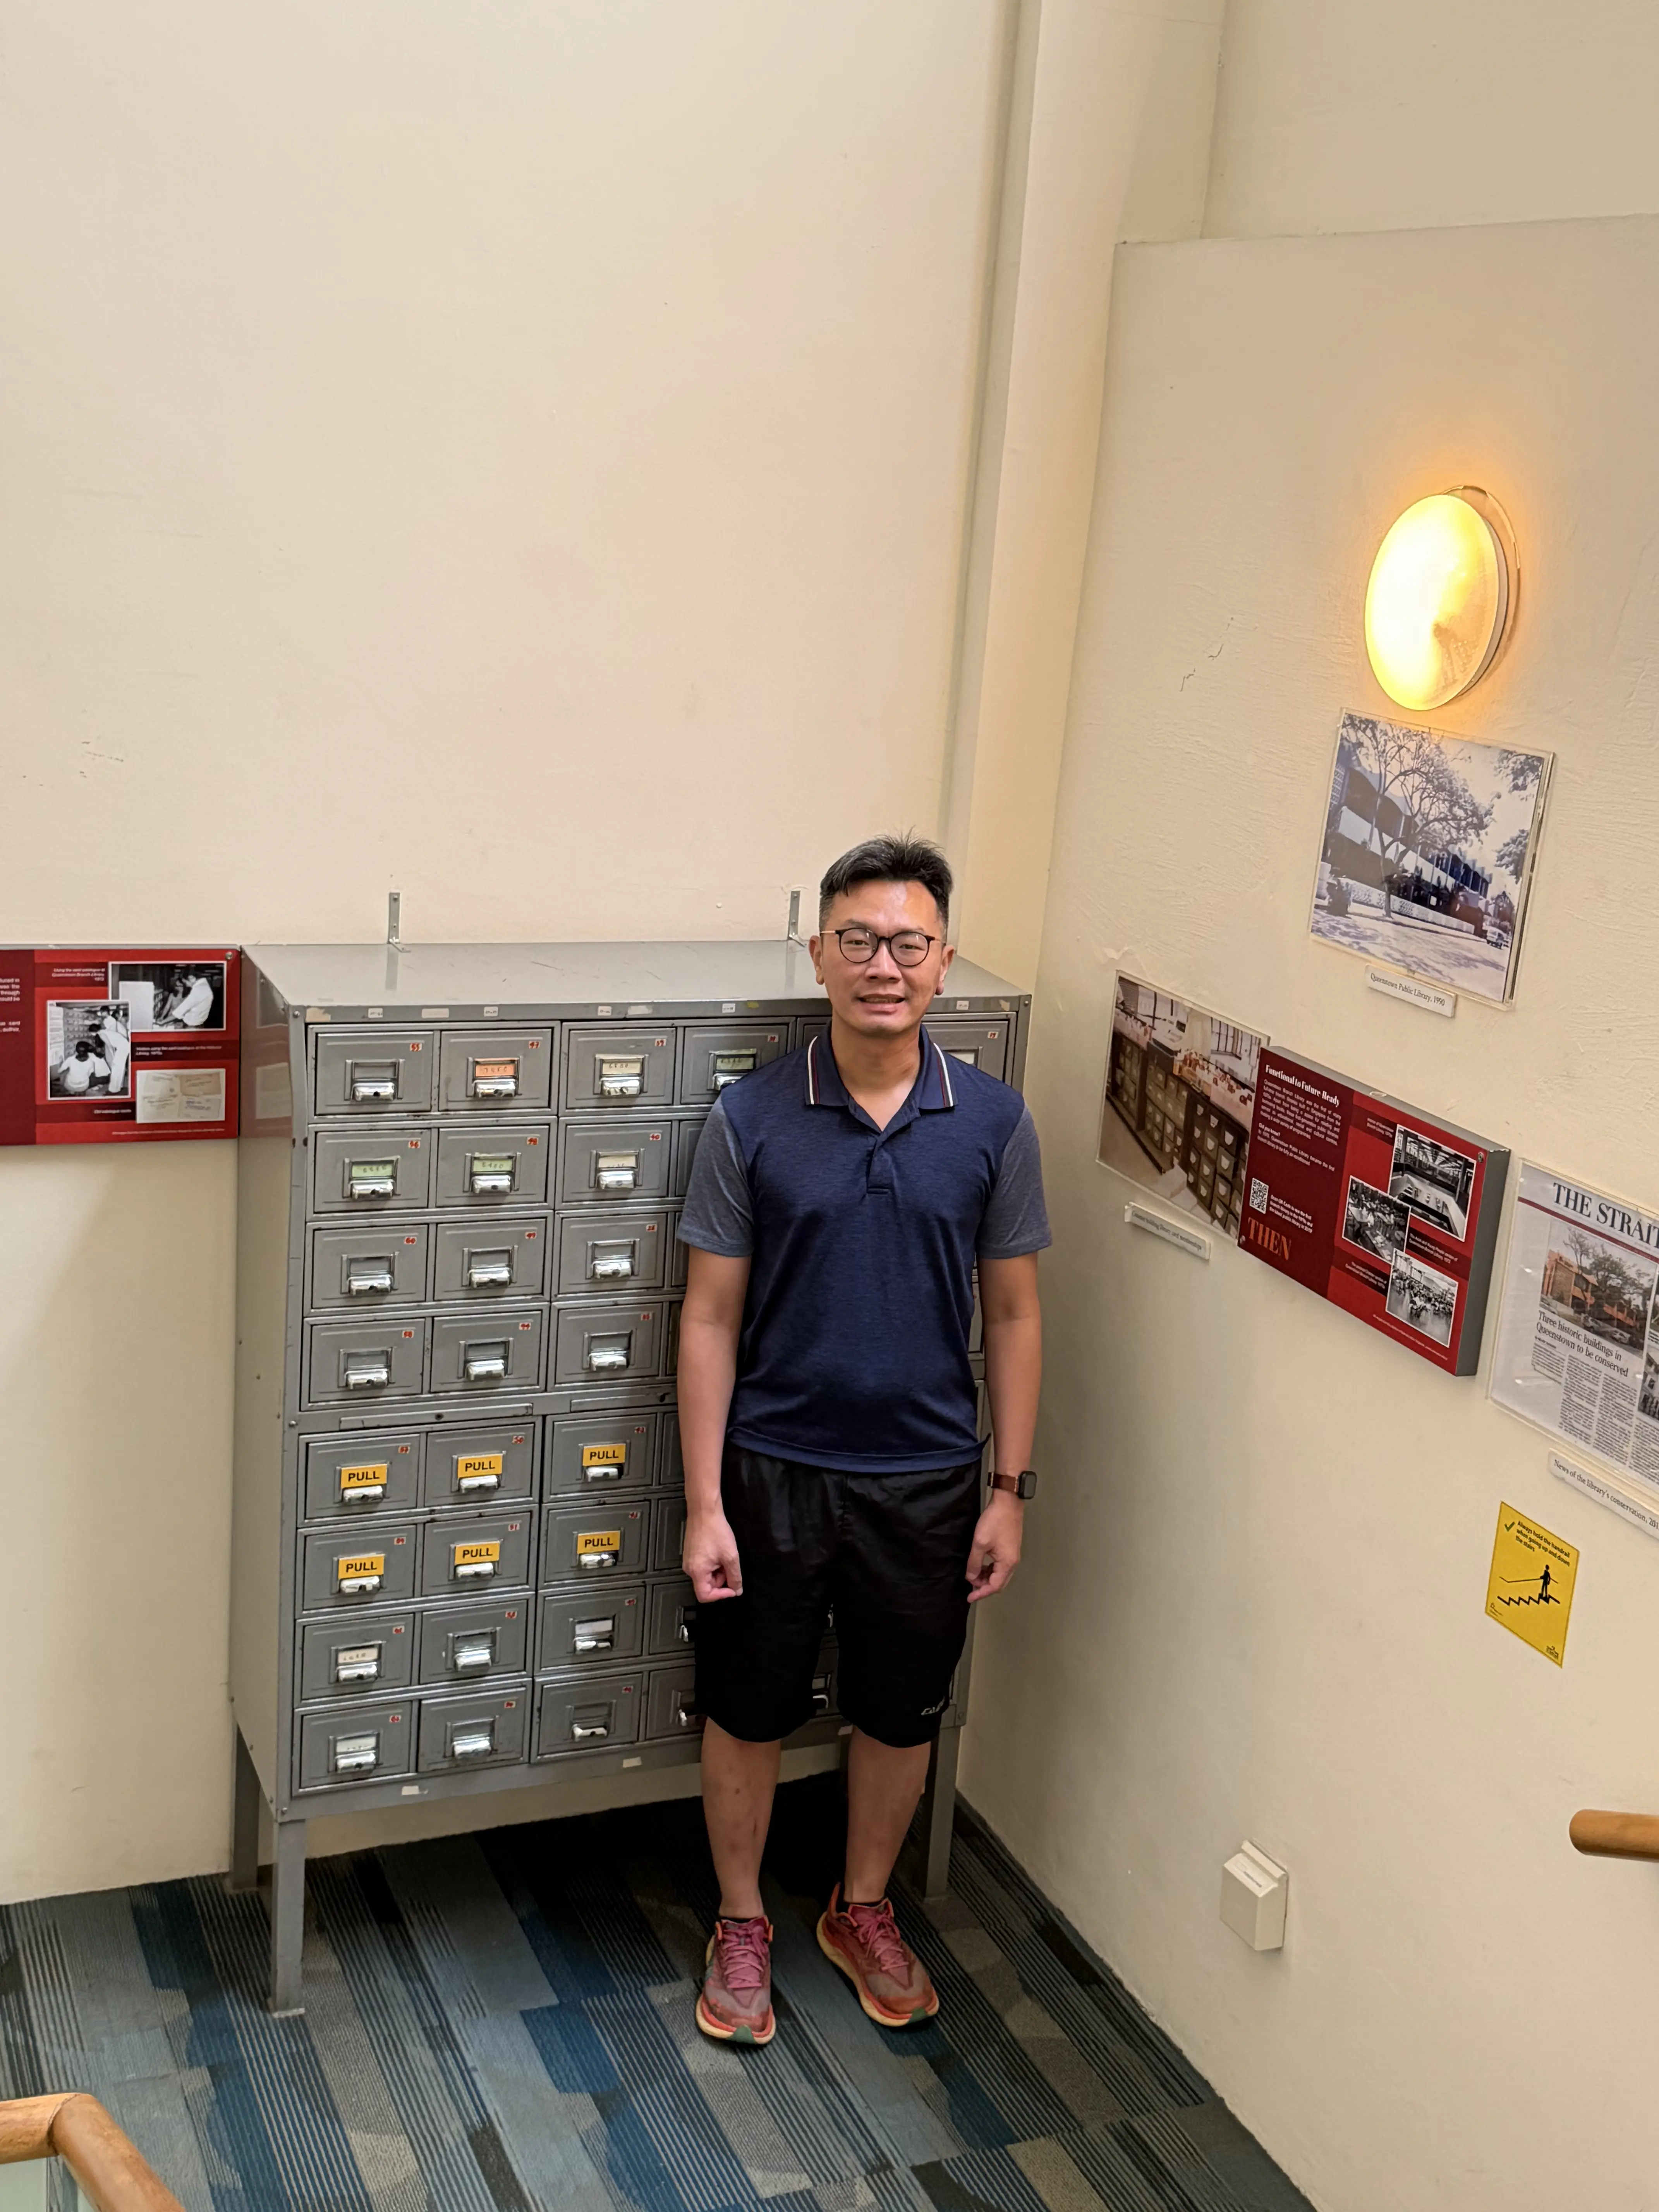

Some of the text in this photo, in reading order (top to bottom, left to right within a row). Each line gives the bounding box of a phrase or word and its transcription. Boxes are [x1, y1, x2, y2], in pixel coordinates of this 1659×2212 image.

[1398, 982, 1413, 994] Public
[1266, 1064, 1295, 1084] Functional
[1295, 1078, 1301, 1088] to
[1553, 1182, 1592, 1218] THE
[1248, 1217, 1291, 1260] THEN
[1539, 1310, 1622, 1361] Three historic buildings in
[1536, 1322, 1575, 1349] Queenstown
[1577, 1344, 1583, 1353] to
[1585, 1346, 1594, 1359] be
[1594, 1355, 1628, 1377] conserved
[465, 1461, 495, 1472] PULL
[590, 1450, 618, 1461] PULL
[348, 1471, 380, 1481] PULL
[1554, 1459, 1569, 1474] News
[1577, 1474, 1586, 1484] the
[1649, 1517, 1659, 1532] 201
[584, 1537, 613, 1548] PULL
[1516, 1528, 1528, 1539] when
[1528, 1537, 1542, 1549] going
[1548, 1549, 1557, 1558] and
[1556, 1555, 1570, 1567] down
[1517, 1520, 1532, 1534] Always
[1533, 1530, 1543, 1541] hold
[1551, 1542, 1570, 1558] handrail
[462, 1548, 493, 1558] PULL
[346, 1561, 377, 1572] PULL
